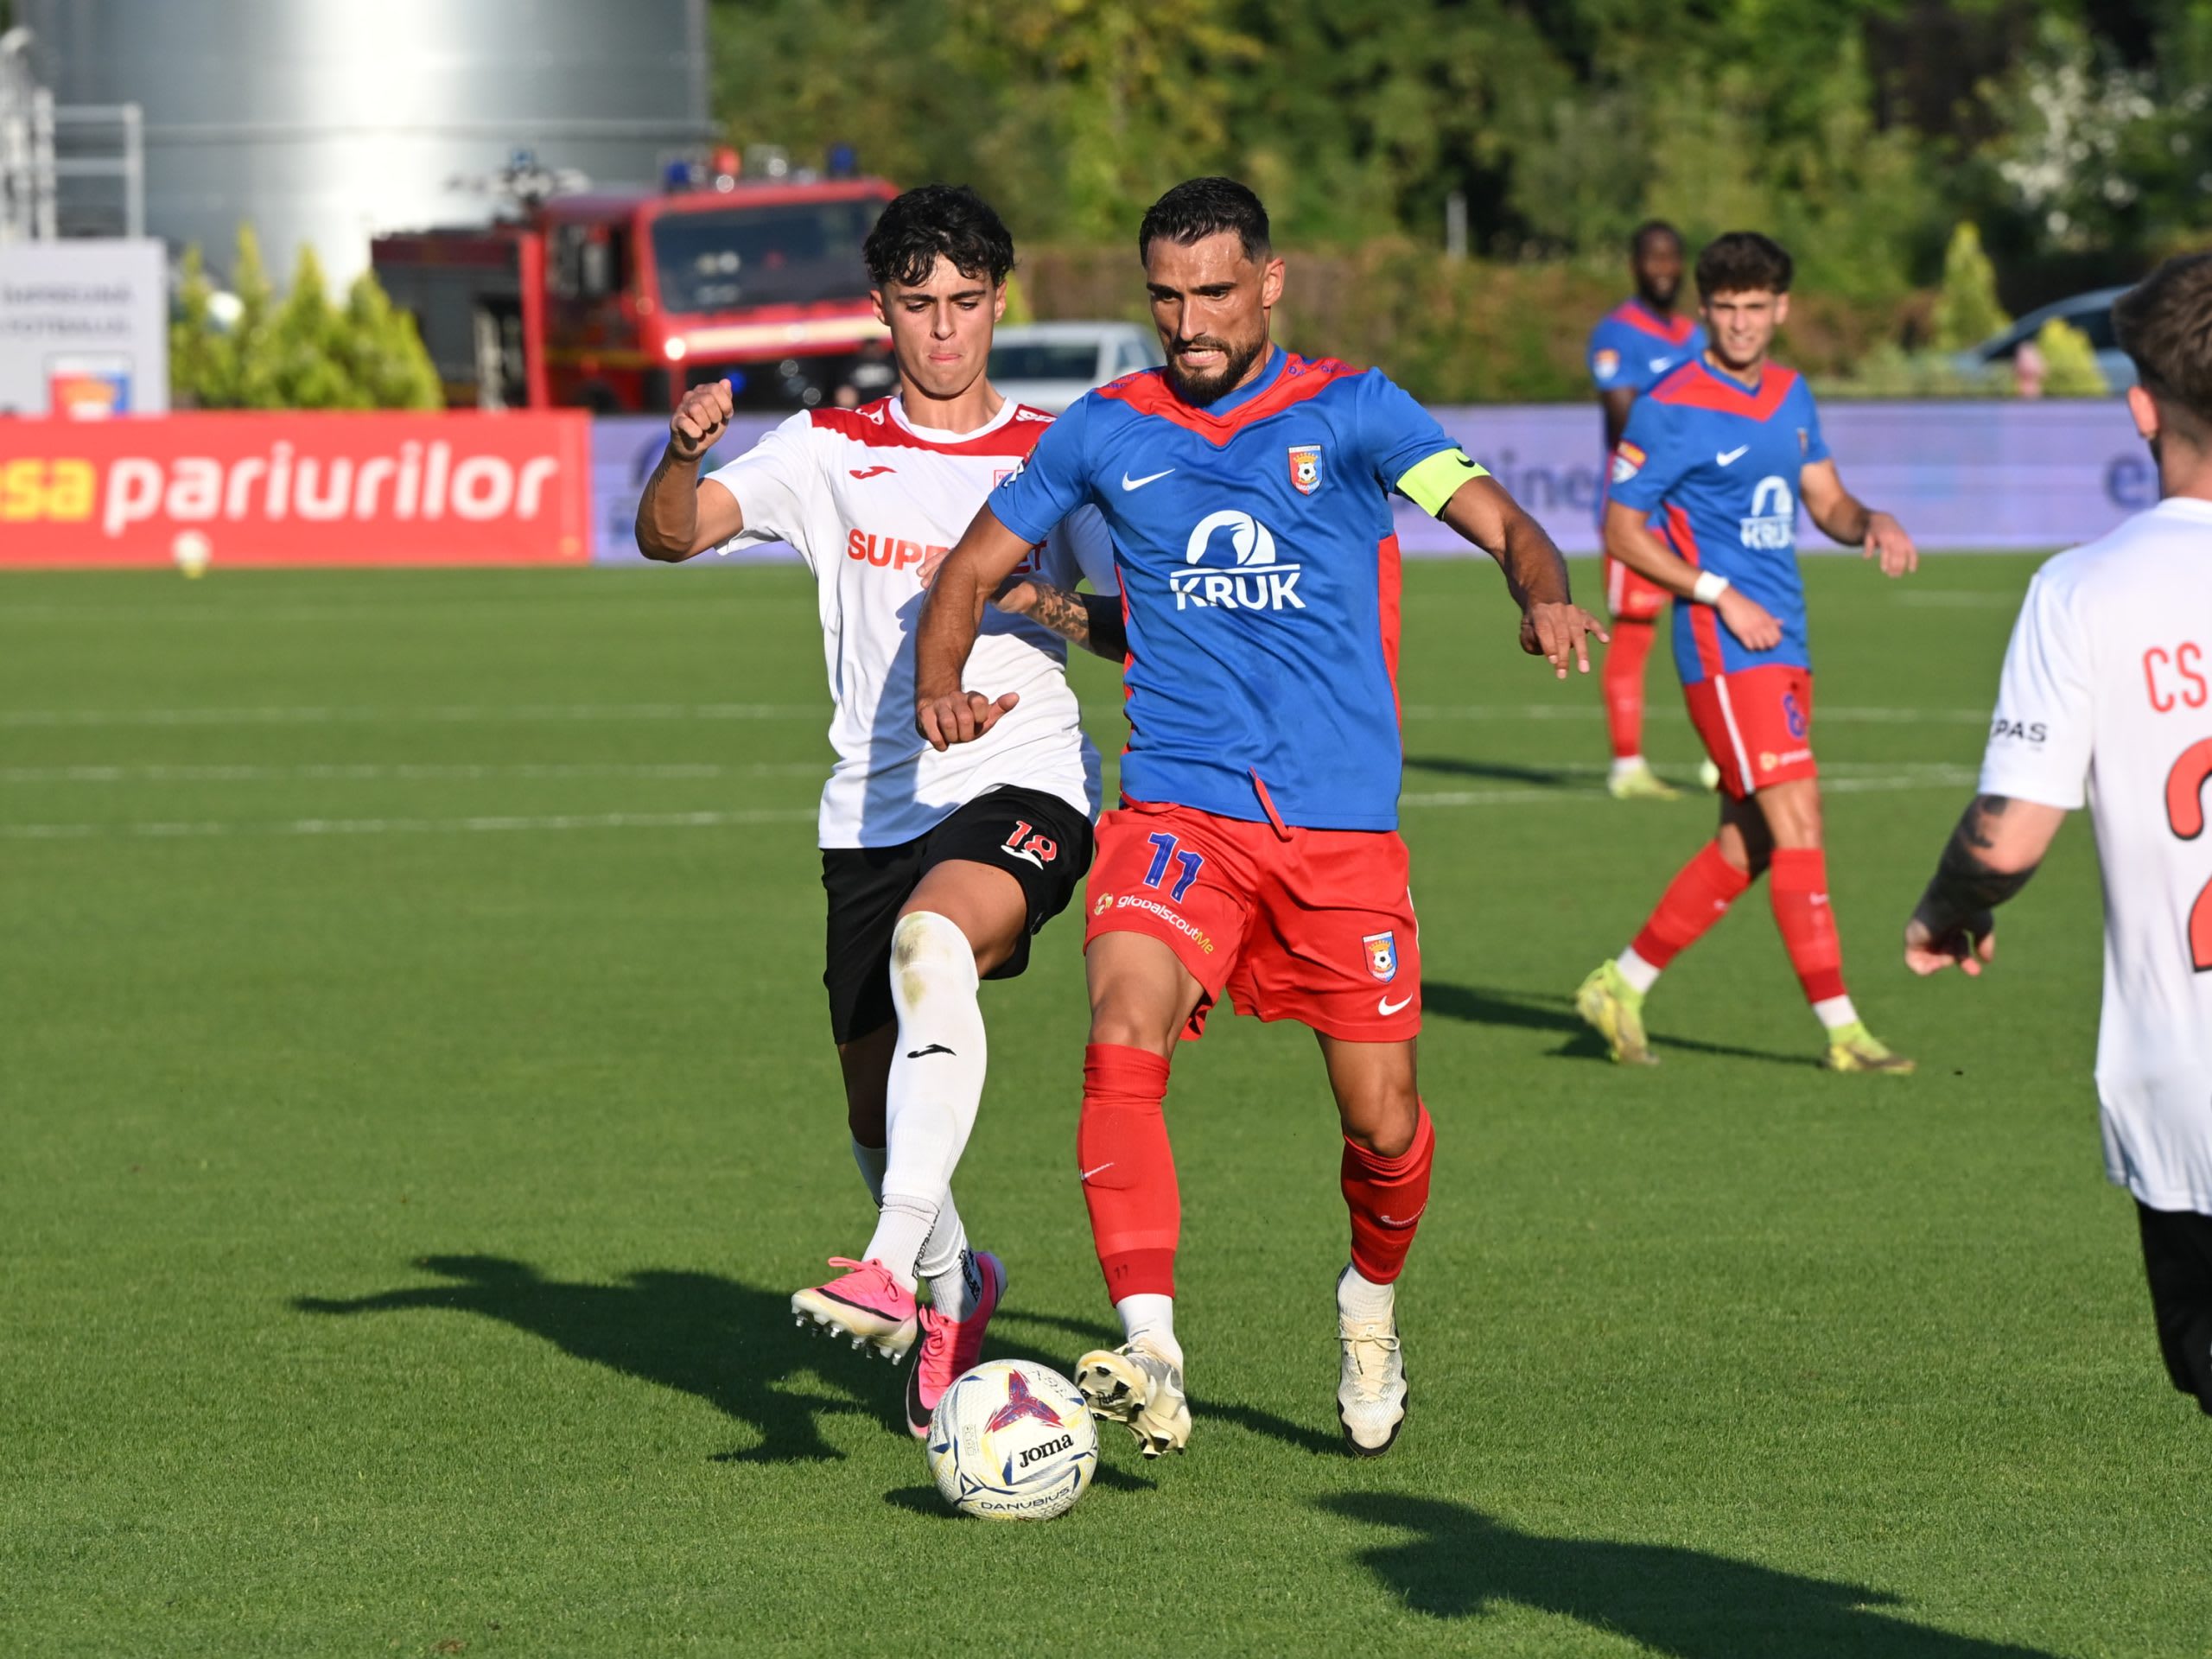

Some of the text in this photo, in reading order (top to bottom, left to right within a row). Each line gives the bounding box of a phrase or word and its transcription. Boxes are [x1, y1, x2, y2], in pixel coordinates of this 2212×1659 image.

[103, 440, 560, 537] pariurilor
[1169, 573, 1306, 611] KRUK
[1006, 819, 1058, 863] 18
[1142, 831, 1205, 905] 11
[1019, 1433, 1074, 1469] Joma
[980, 1486, 1071, 1511] DANUBIUS
